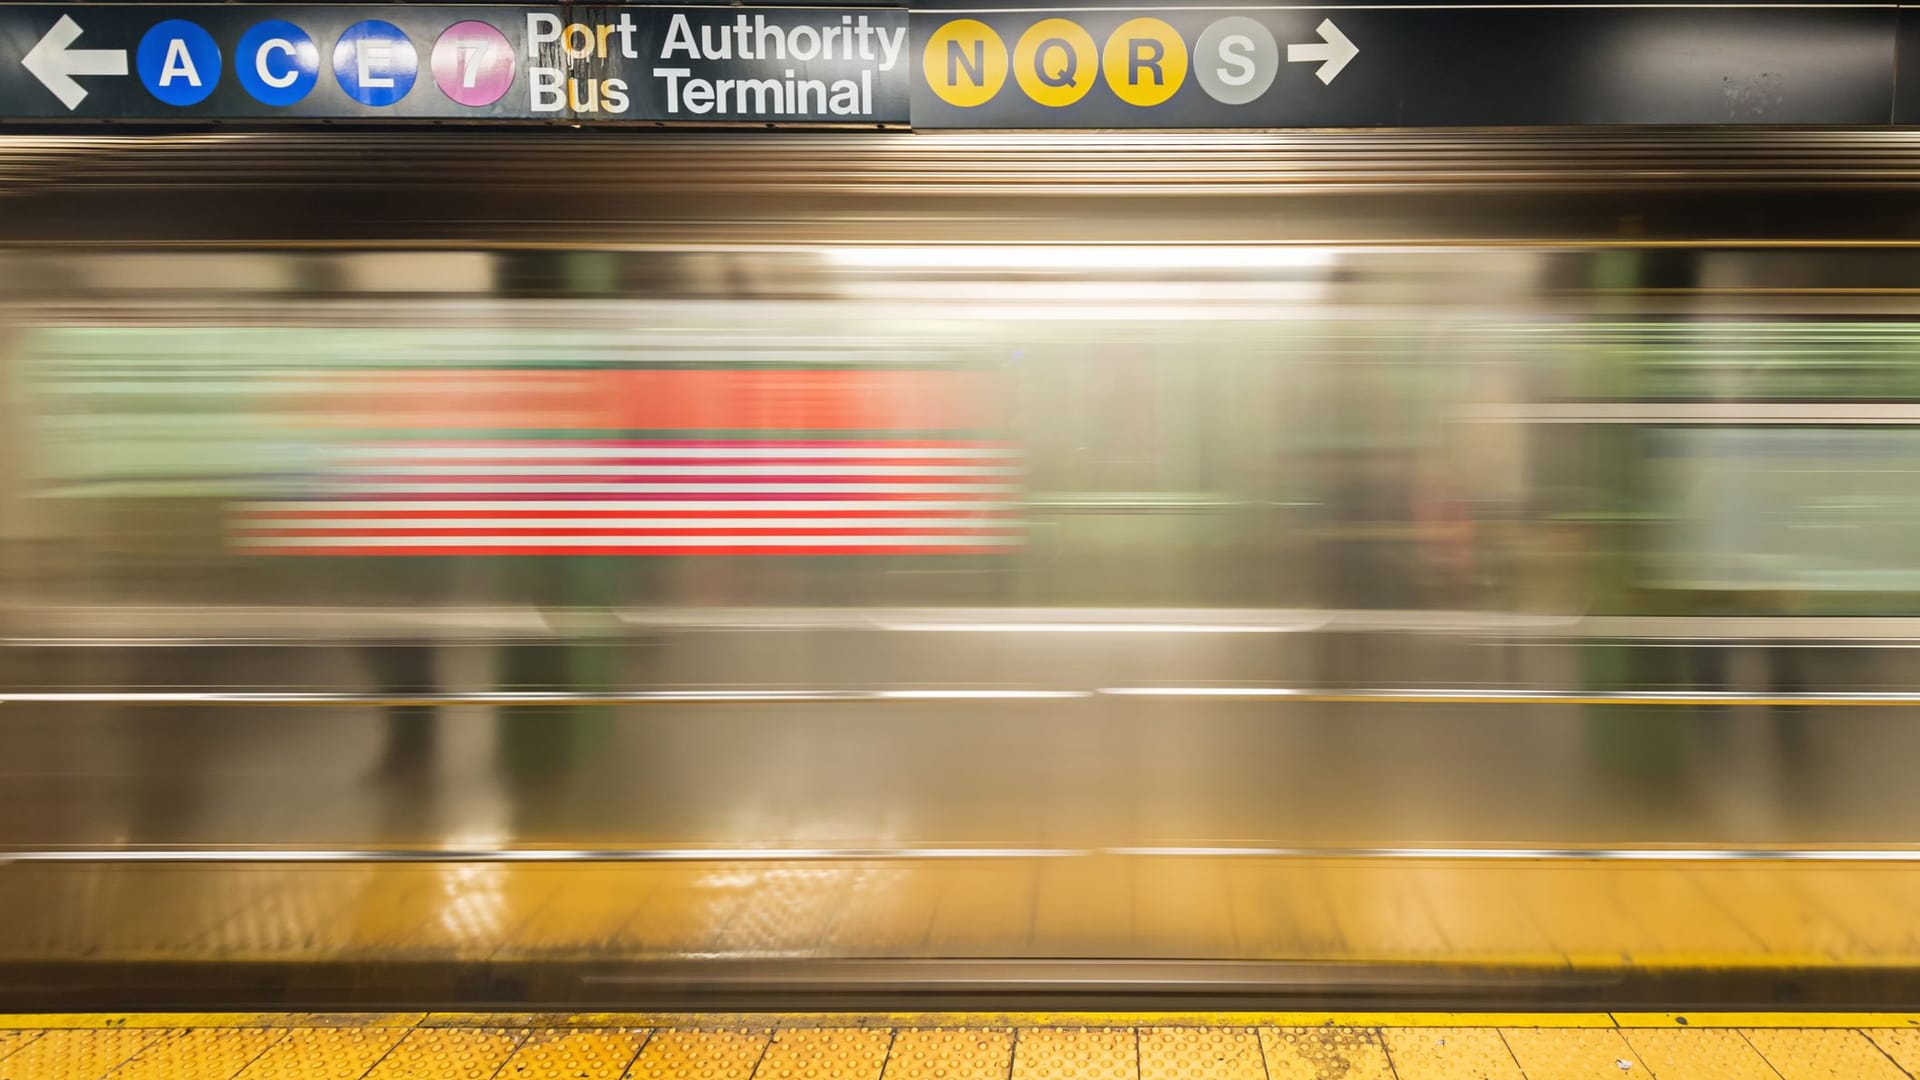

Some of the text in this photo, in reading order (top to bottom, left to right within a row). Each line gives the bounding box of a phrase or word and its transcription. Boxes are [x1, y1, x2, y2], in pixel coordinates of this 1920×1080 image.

[158, 38, 488, 88] A C E 7
[527, 13, 906, 71] Port Authority
[946, 35, 1256, 88] N Q R S
[530, 67, 872, 115] Bus Terminal
